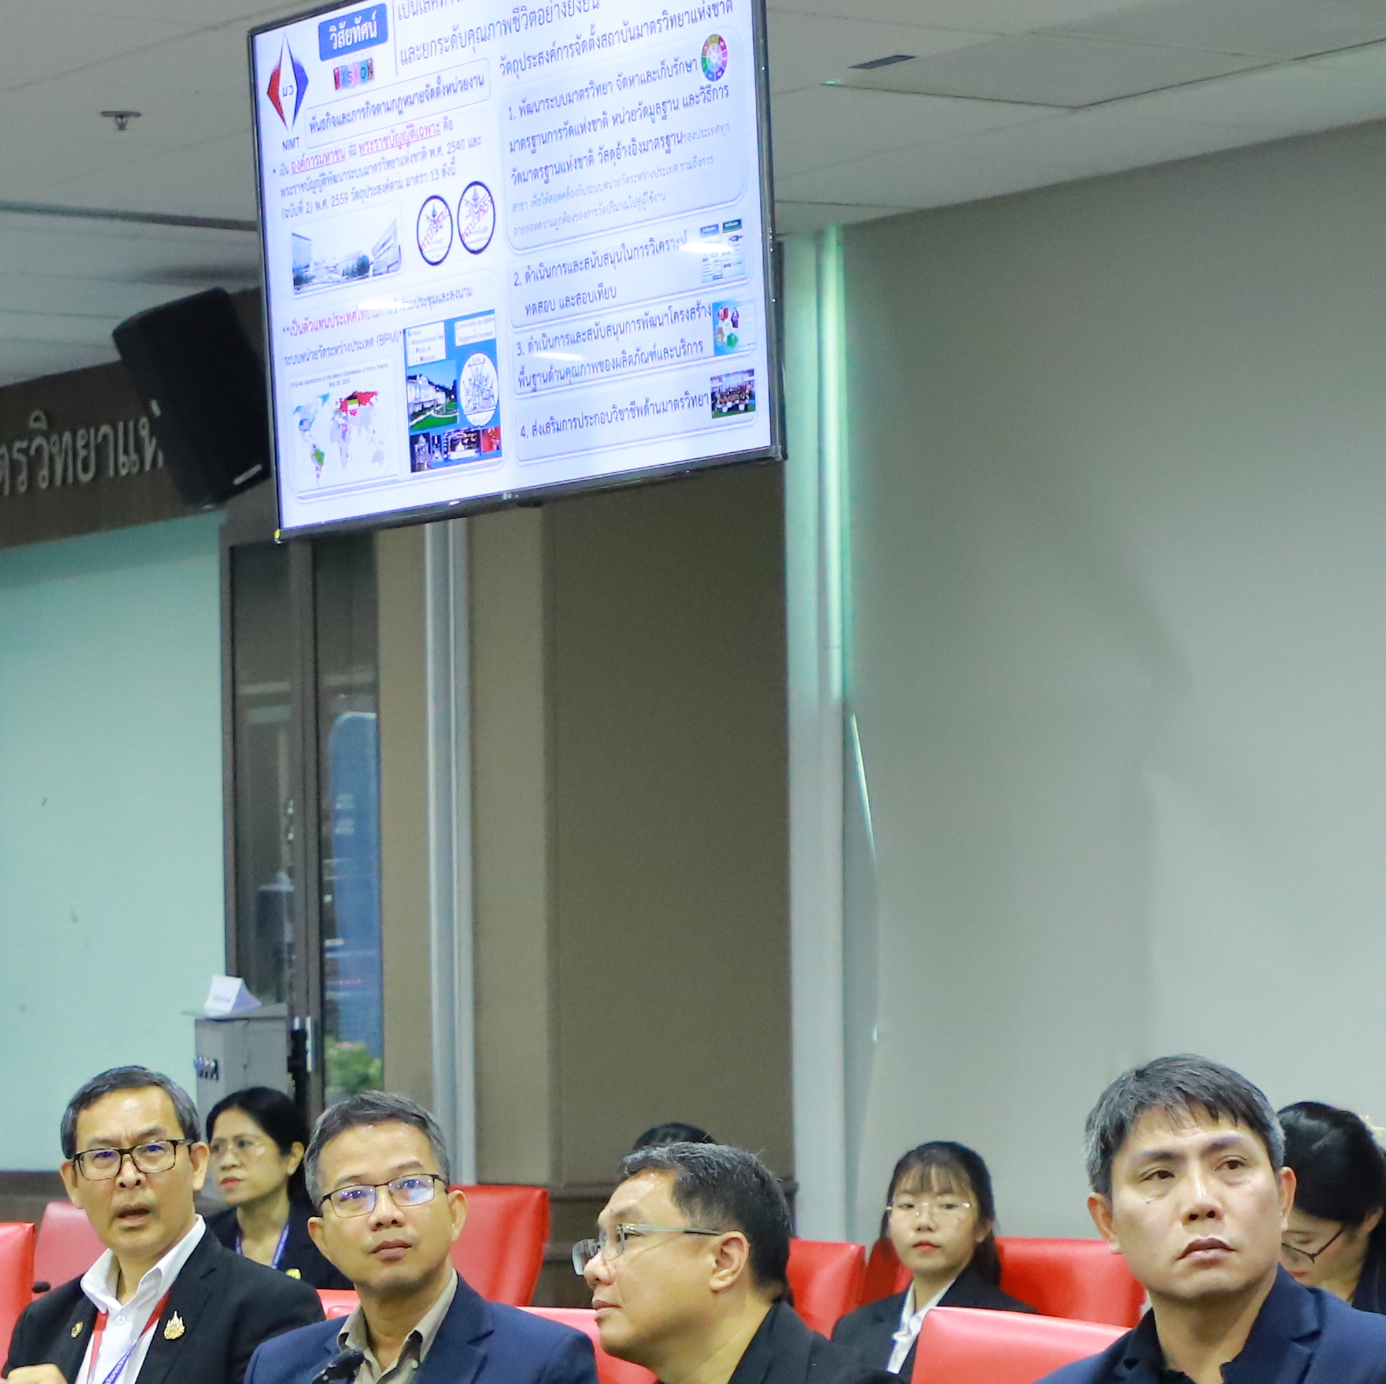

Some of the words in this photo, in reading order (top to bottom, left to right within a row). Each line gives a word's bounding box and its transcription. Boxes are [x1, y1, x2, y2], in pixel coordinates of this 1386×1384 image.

[329, 11, 377, 50] วิสัยทัศน์
[519, 80, 613, 118] พัฒนาระบบมาตรวิทยา
[616, 56, 698, 91] จัดหาและเก็บรักษา
[509, 111, 609, 154] มาตรฐานการวัดแห่งชาติ
[682, 84, 729, 108] และวิธีการ
[282, 136, 300, 151] NIMT
[514, 271, 522, 286] 2.
[525, 302, 556, 317] ทดสอบ
[559, 282, 617, 309] และสอบเทียบ
[516, 342, 525, 356] 3.
[521, 425, 529, 439] 4.
